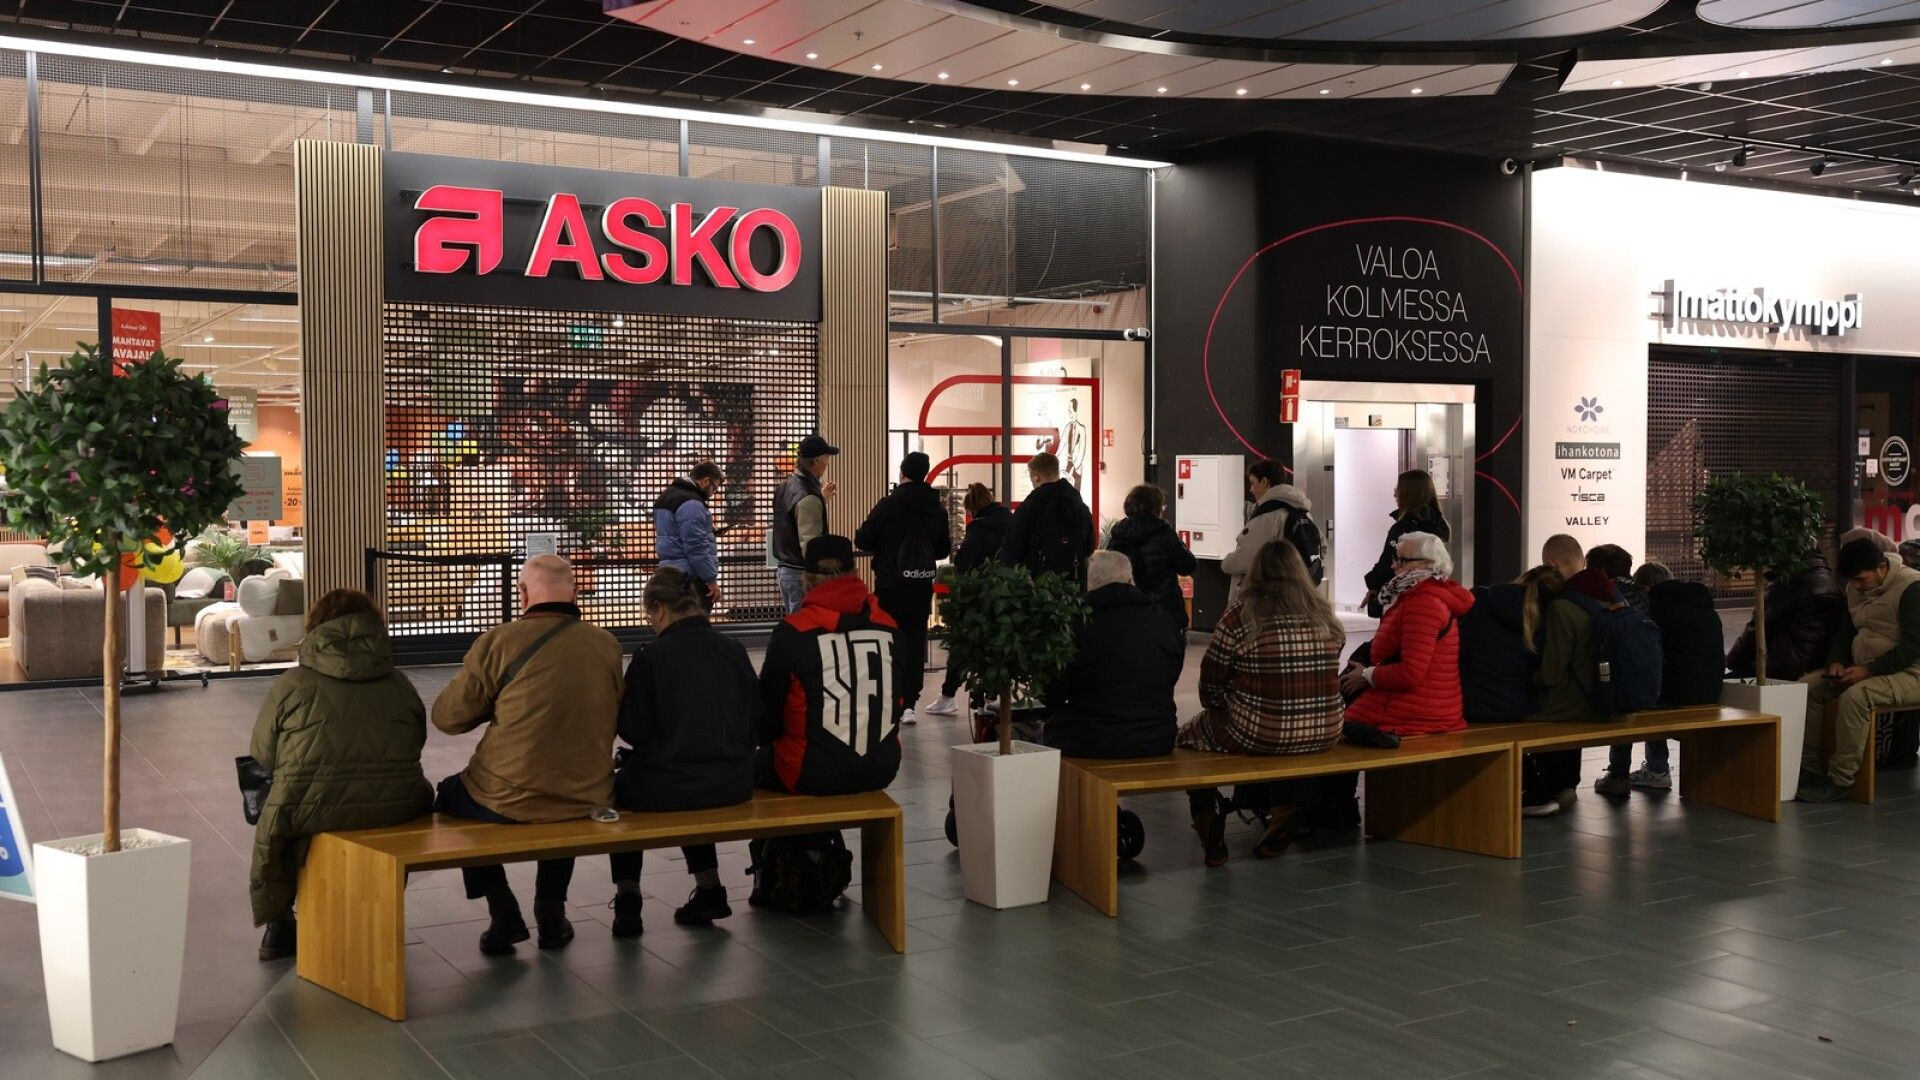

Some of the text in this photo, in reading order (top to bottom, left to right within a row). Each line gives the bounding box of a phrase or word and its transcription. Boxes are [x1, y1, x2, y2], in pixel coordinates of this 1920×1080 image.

[524, 192, 801, 293] ASKO
[1355, 243, 1440, 280] VALOA
[1326, 284, 1468, 322] KOLMESSA
[1679, 287, 1864, 337] mattokymppi
[112, 336, 156, 347] MAHTAVAT
[1299, 324, 1491, 364] KERROKSESSA
[1557, 445, 1620, 458] ihankotona
[1561, 467, 1613, 482] VM Carpet
[1565, 517, 1610, 526] VALLEY
[902, 569, 936, 579] adidas
